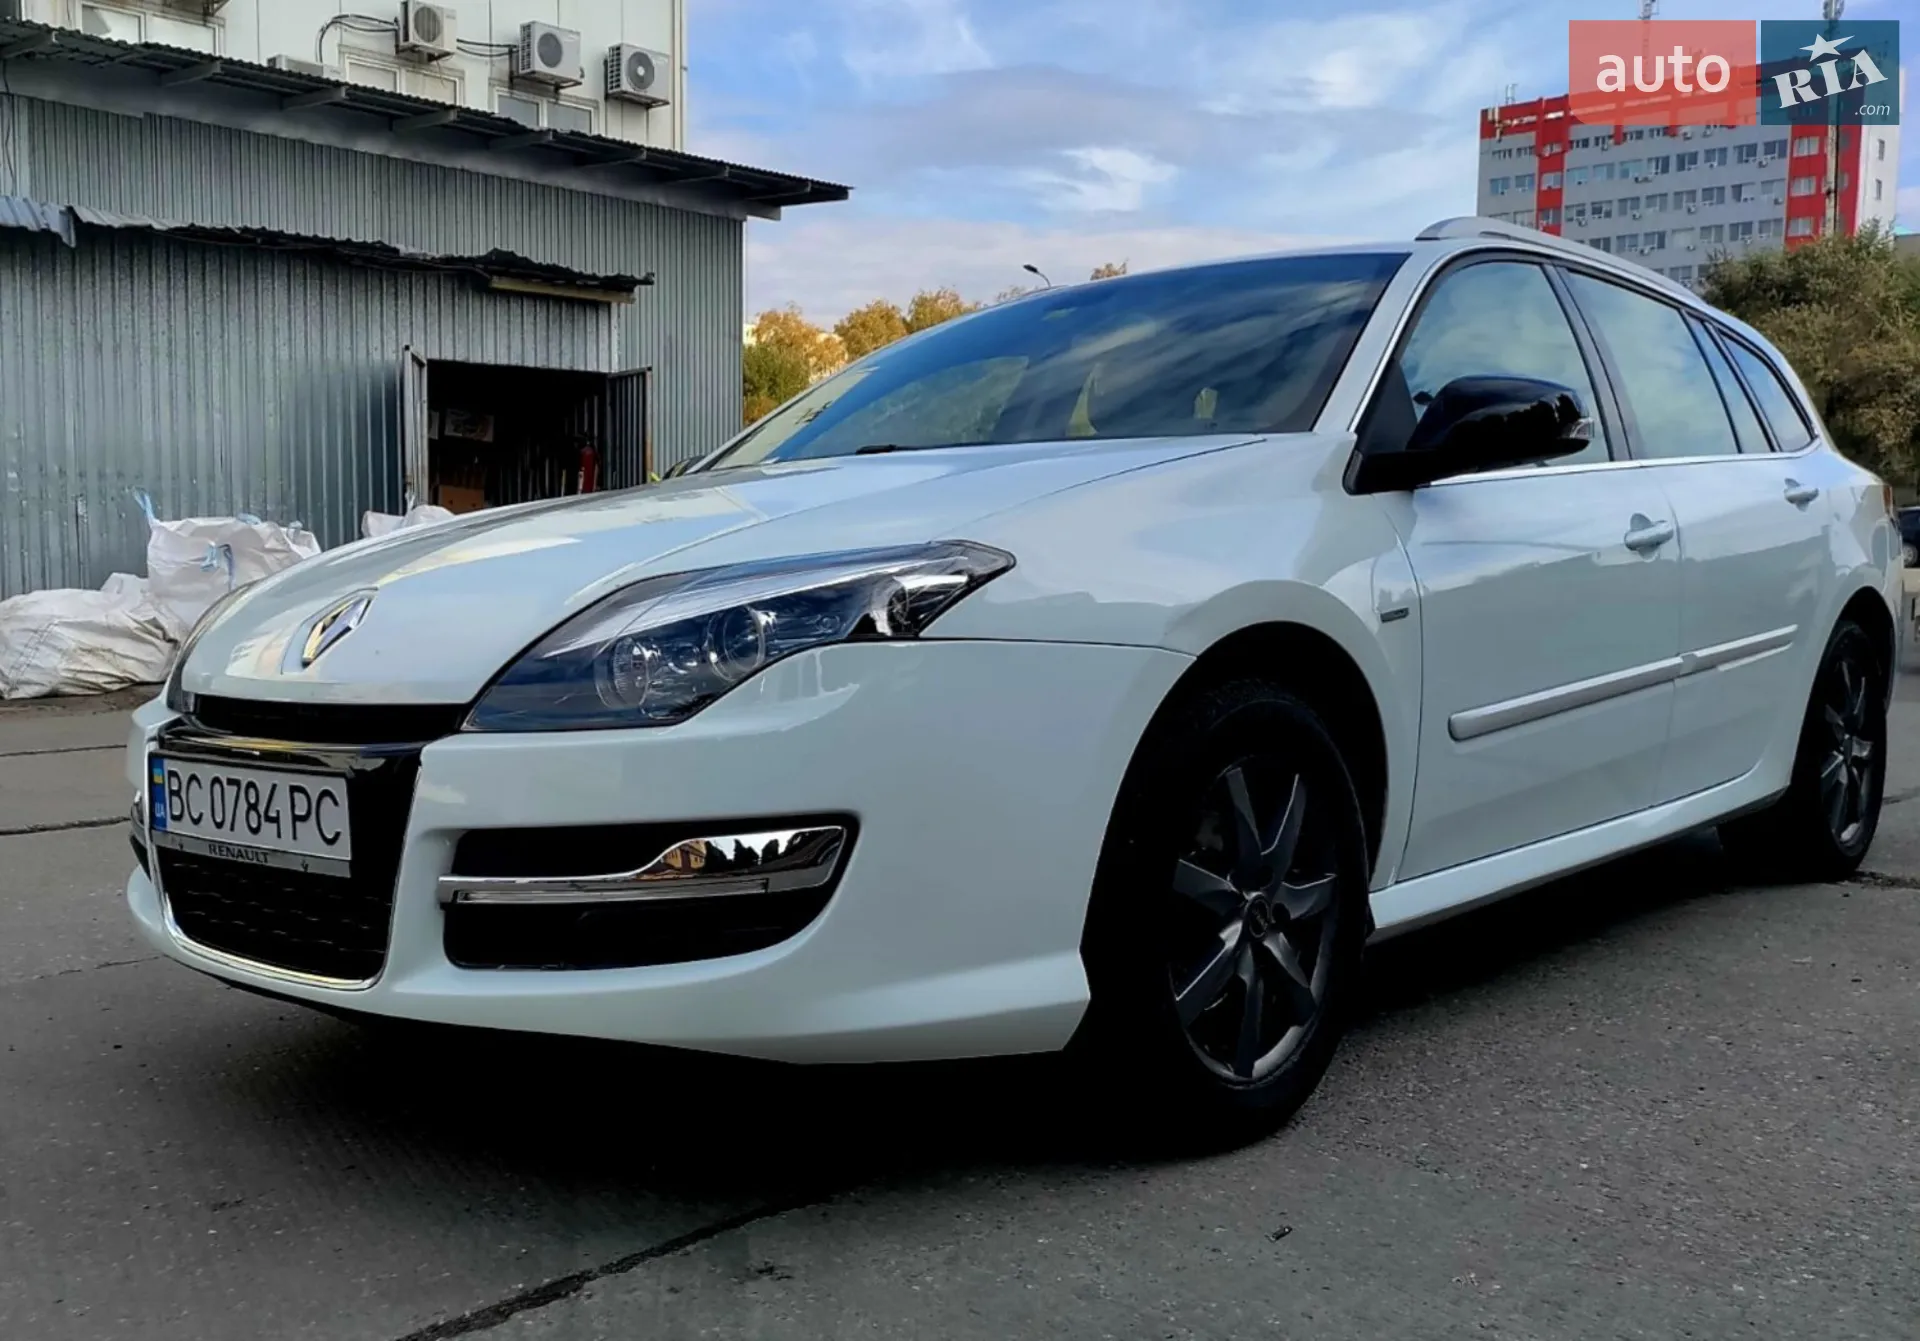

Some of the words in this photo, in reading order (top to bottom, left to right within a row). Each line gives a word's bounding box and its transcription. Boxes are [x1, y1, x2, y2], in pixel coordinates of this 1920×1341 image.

[167, 769, 203, 825] BC
[210, 776, 281, 838] 0784
[289, 784, 341, 845] PC
[208, 843, 269, 864] RENAULT
